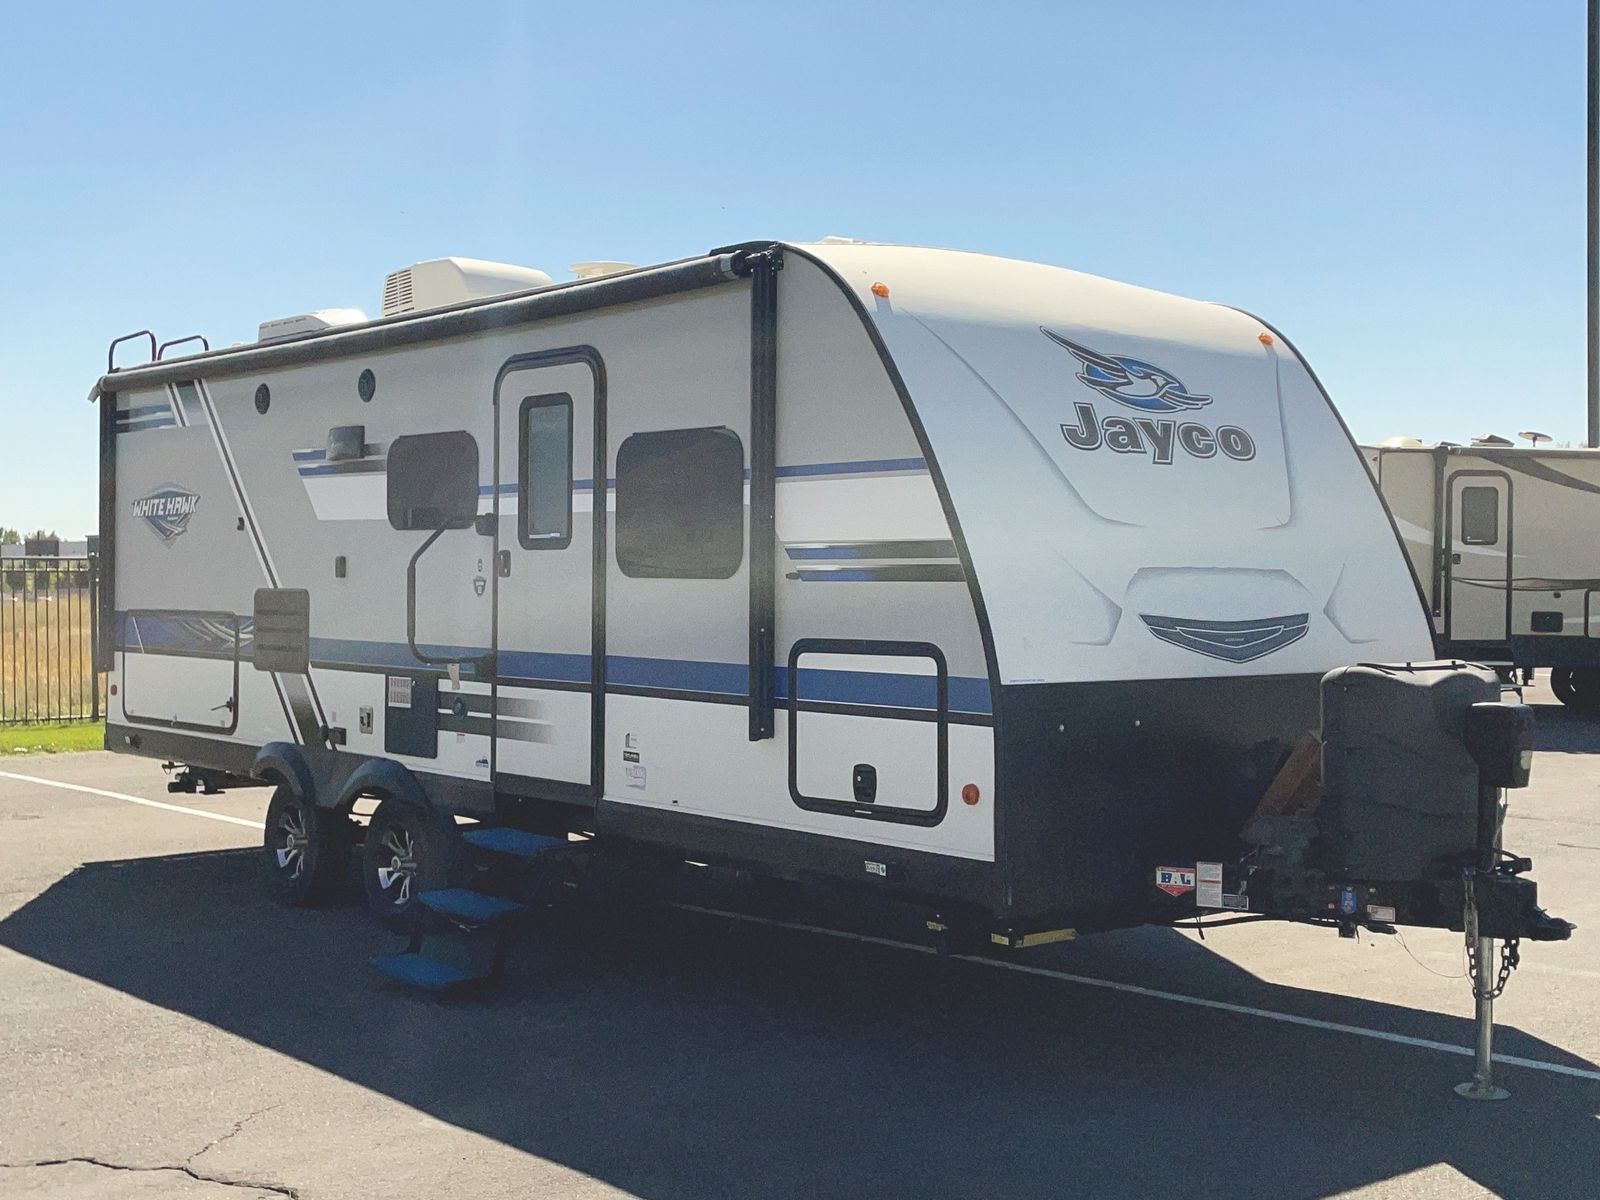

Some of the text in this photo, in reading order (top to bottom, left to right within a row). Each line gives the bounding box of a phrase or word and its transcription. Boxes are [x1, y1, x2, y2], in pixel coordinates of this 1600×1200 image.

[1060, 402, 1256, 465] Jayco
[132, 495, 200, 517] WHITE HAWK
